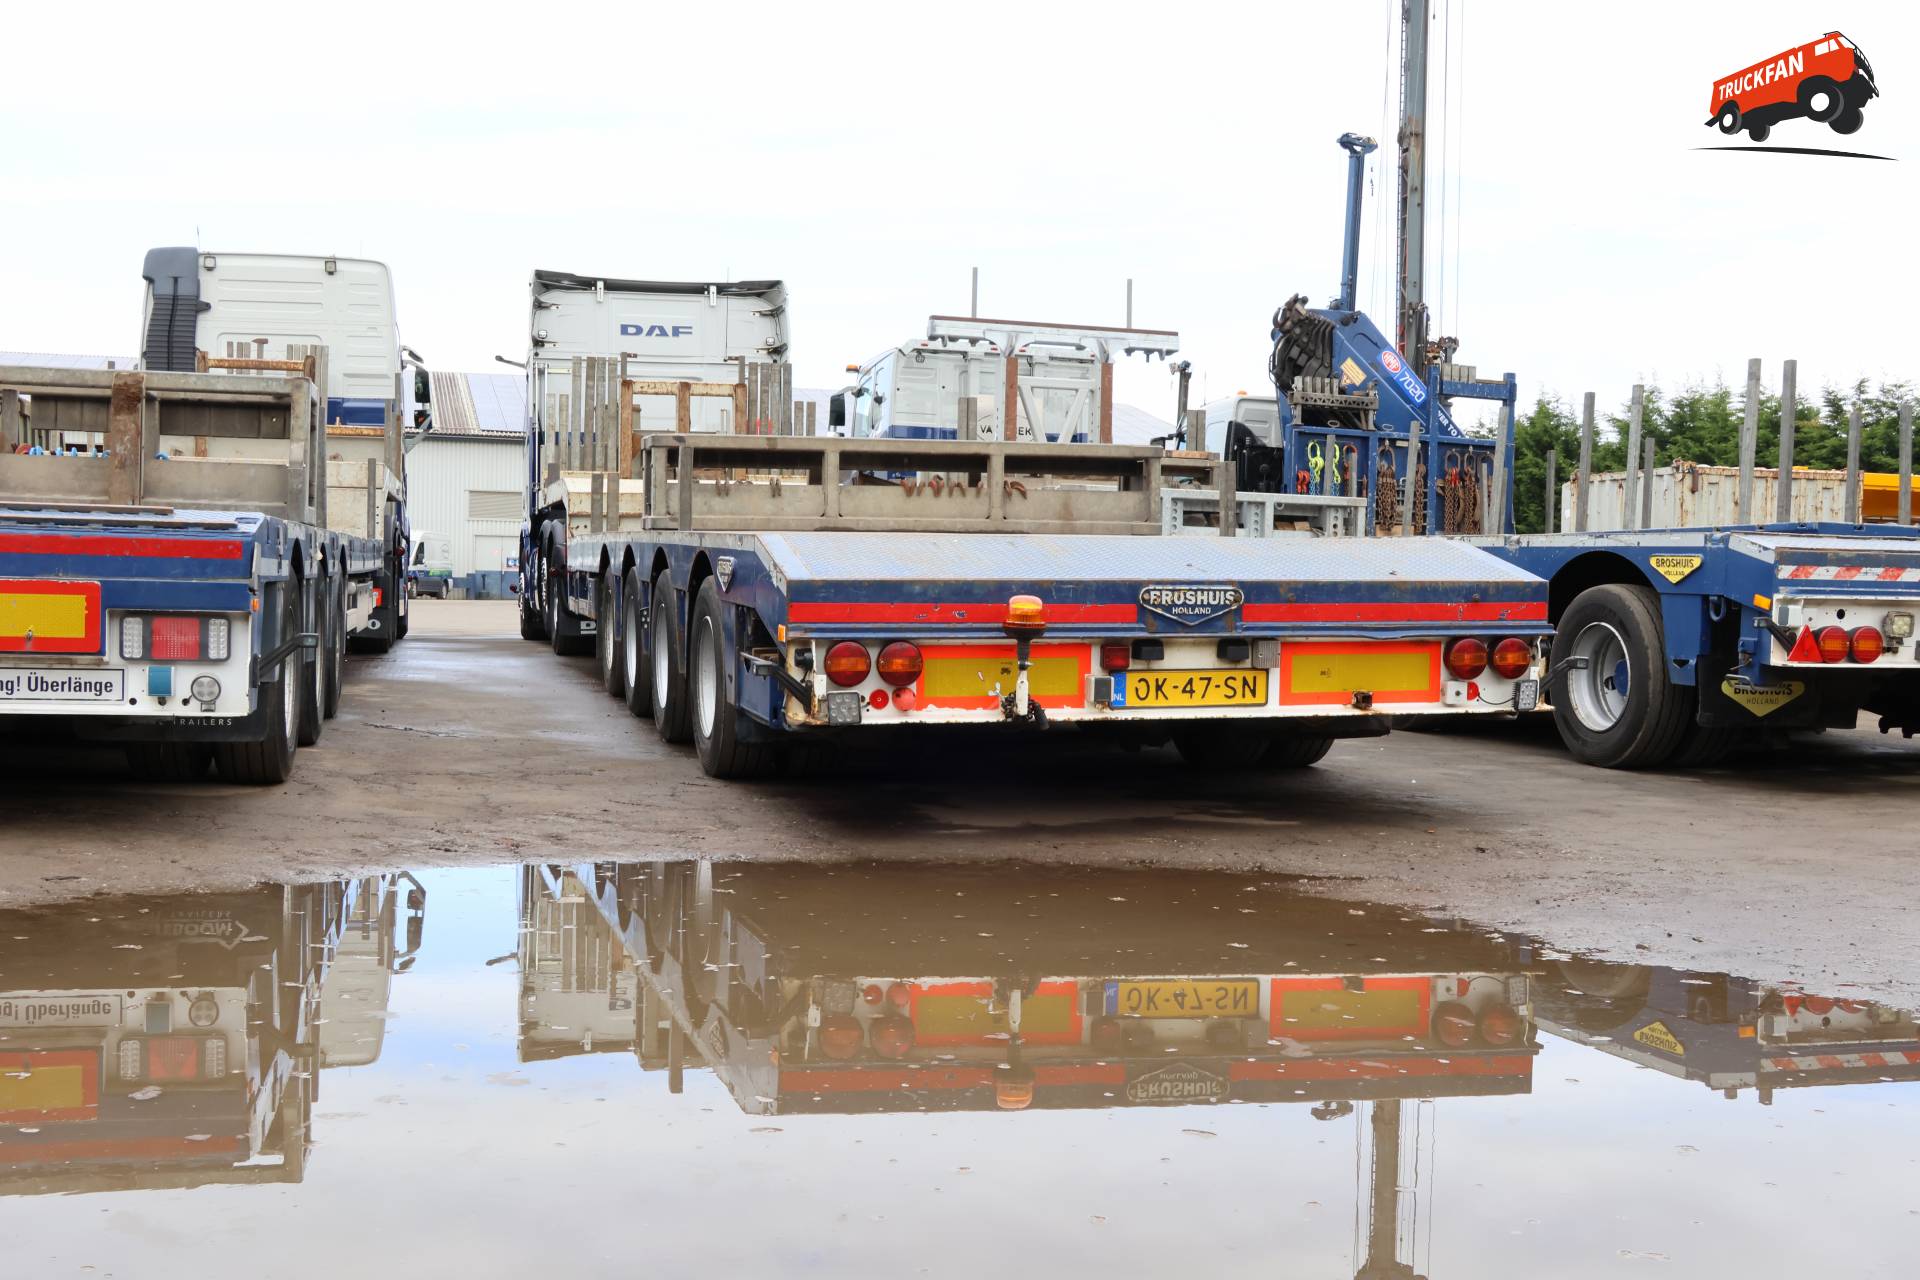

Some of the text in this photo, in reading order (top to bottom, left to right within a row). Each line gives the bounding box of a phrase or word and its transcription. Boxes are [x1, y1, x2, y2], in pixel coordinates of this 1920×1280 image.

[620, 323, 693, 337] DAF
[1400, 371, 1426, 403] 7020
[1448, 423, 1458, 437] TO
[1656, 558, 1695, 568] BROSHUIS
[1172, 606, 1211, 615] HOLLAND
[27, 671, 113, 696] Überlänge
[1135, 676, 1257, 701] OK-47-SN
[1114, 693, 1124, 701] NL
[1746, 697, 1779, 705] HOLLAND
